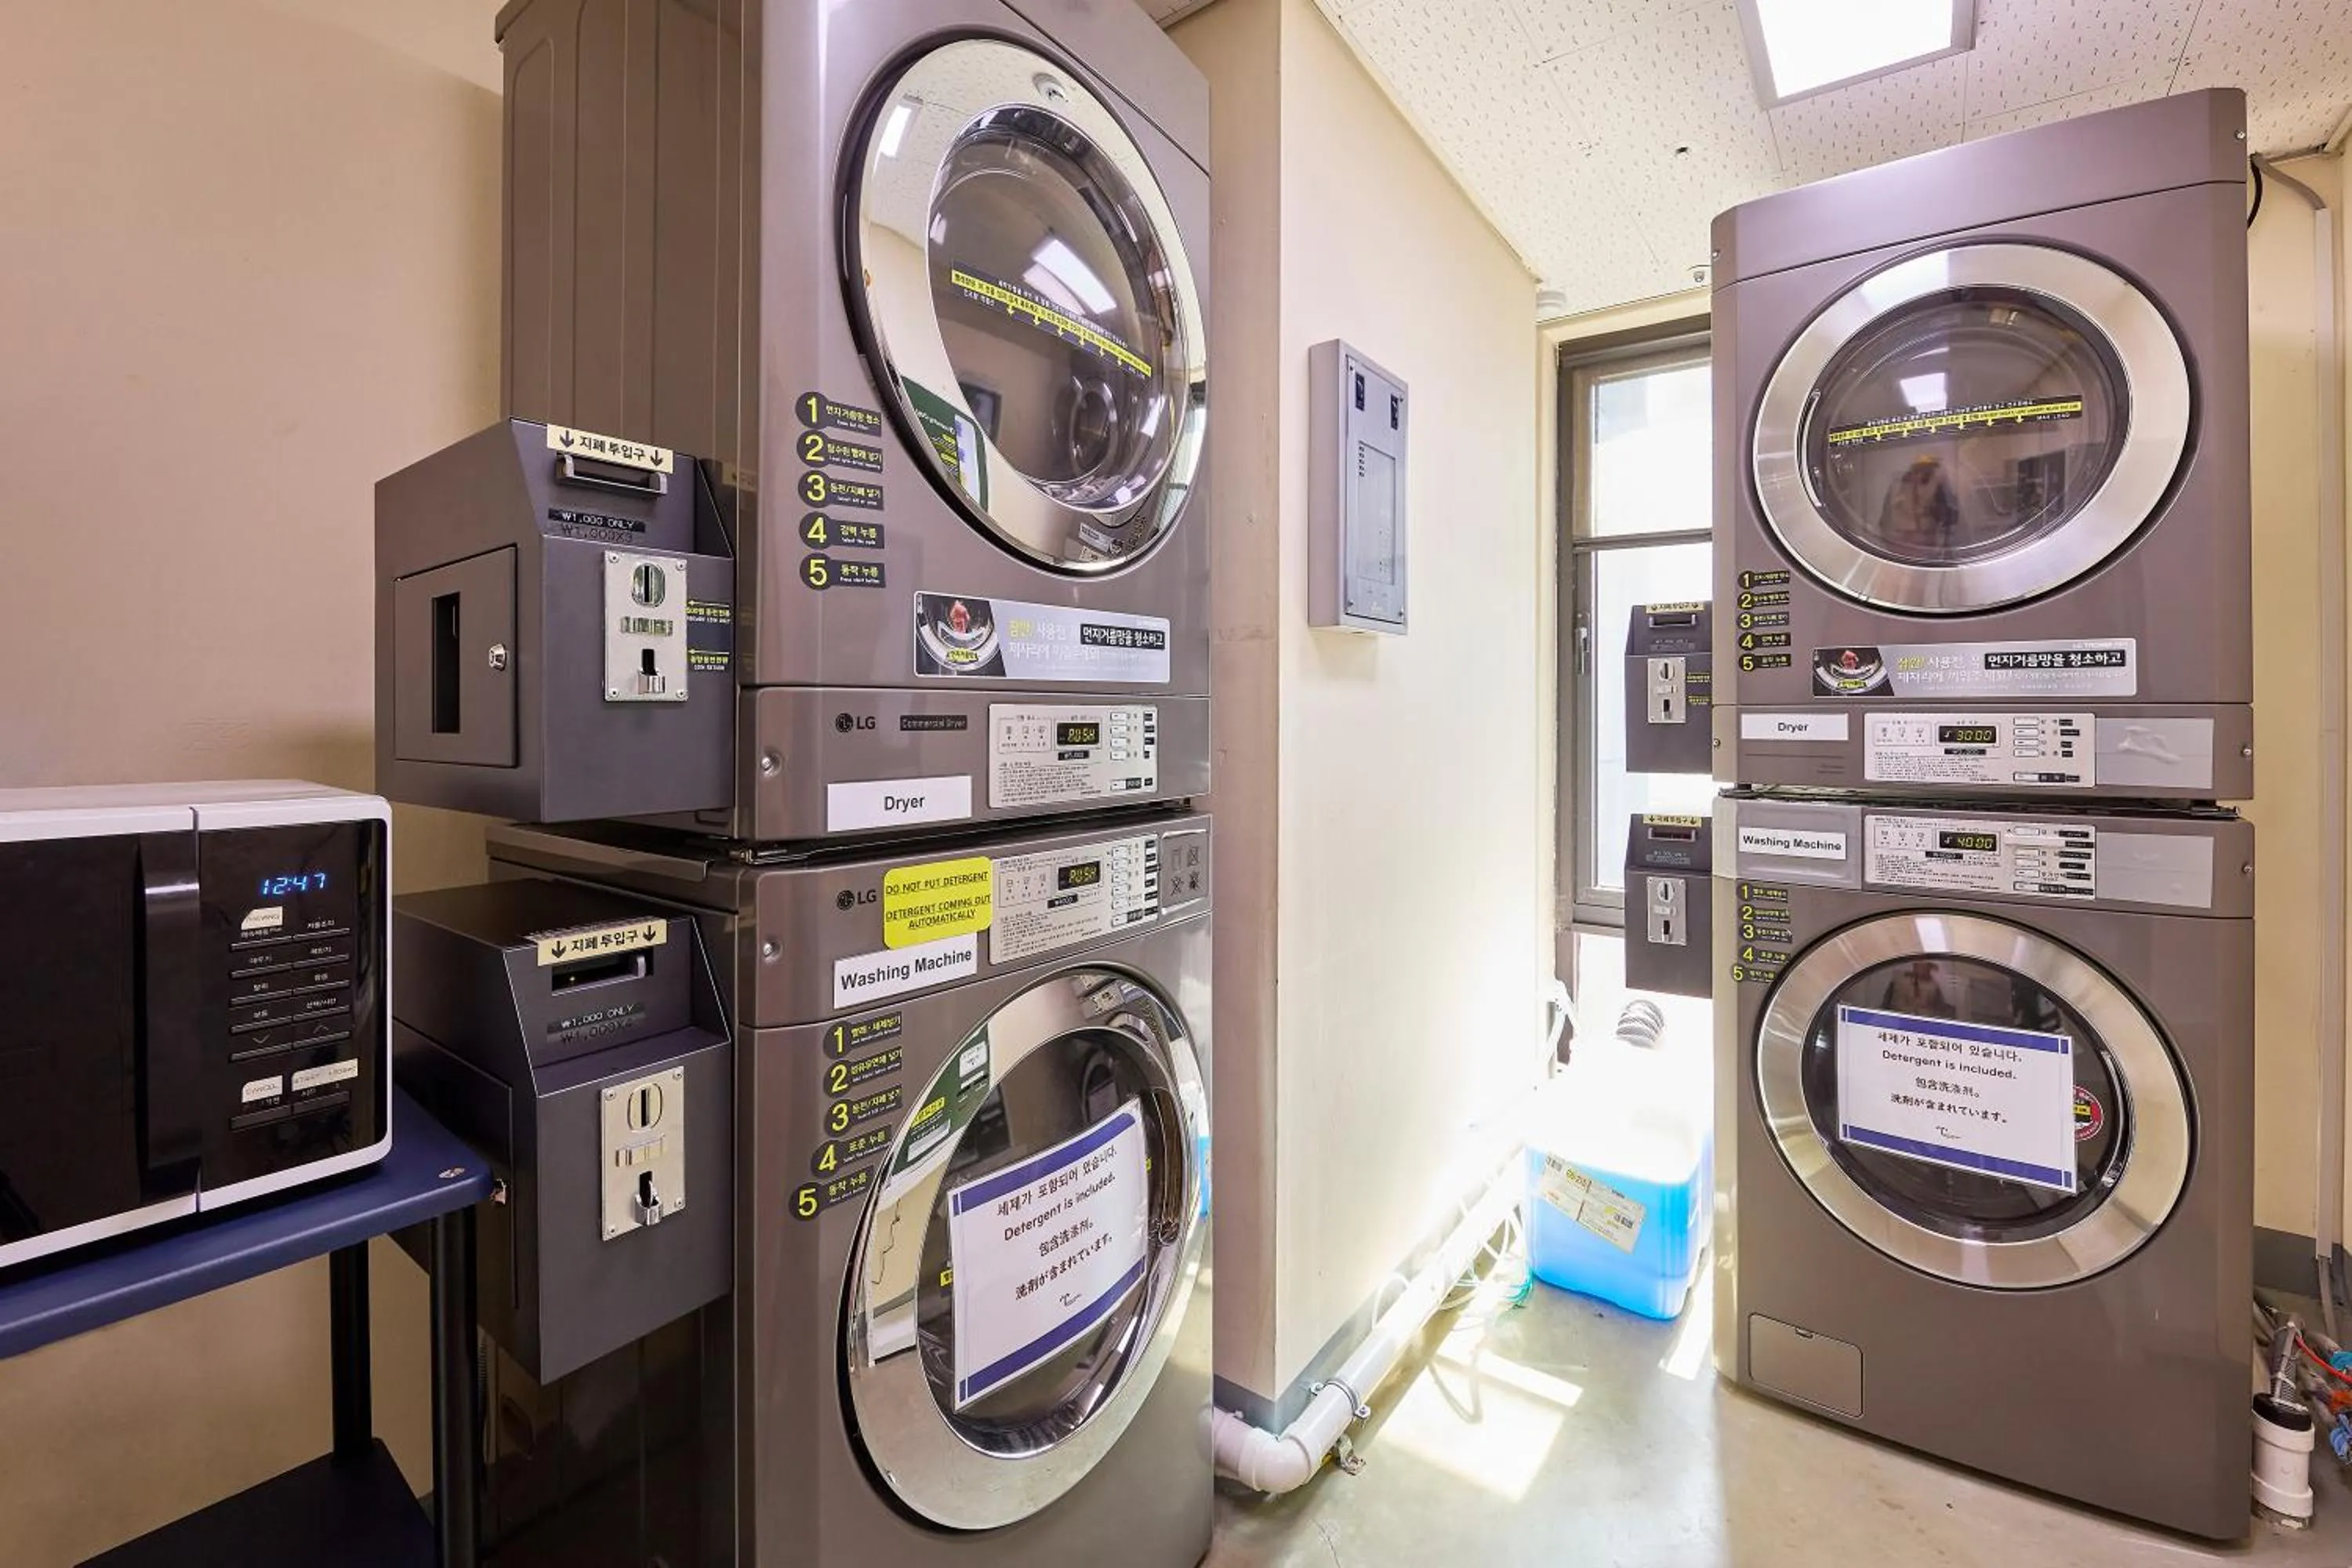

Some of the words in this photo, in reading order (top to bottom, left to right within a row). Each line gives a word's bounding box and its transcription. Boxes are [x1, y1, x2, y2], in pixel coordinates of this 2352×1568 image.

[806, 397, 818, 423] 1
[579, 435, 606, 452] 지폐
[608, 441, 645, 461] 투입구
[805, 434, 825, 461] 2
[807, 474, 826, 501] 3
[807, 517, 827, 543] 4
[809, 559, 828, 586] 5
[1743, 573, 1749, 587] 1
[1741, 593, 1752, 608] 2
[1740, 614, 1751, 627] 3
[1741, 634, 1754, 648] 4
[1743, 656, 1754, 670] 5
[1988, 652, 2066, 668] 먼지거름망을
[2068, 652, 2124, 667] 청소하고
[856, 716, 877, 730] LG
[1777, 720, 1809, 734] Dryer
[884, 796, 926, 813] Dryer
[1743, 835, 1791, 849] Washing
[1793, 837, 1842, 852] Machine
[261, 873, 327, 895] 12:47
[885, 884, 900, 895] DO
[902, 880, 921, 891] NOT
[924, 877, 941, 889] PUT
[943, 871, 989, 887] DETERGENT
[1742, 884, 1748, 899] 1
[857, 889, 877, 905] LG
[885, 903, 935, 922] DETERGENT
[938, 898, 973, 913] COMING
[975, 894, 992, 906] OUT
[907, 909, 976, 930] AUTOMATICALLY
[1742, 906, 1754, 920] 2
[571, 936, 598, 952] 지폐
[601, 930, 639, 947] 투입구
[1743, 924, 1754, 939] 3
[1743, 947, 1754, 964] 4
[840, 964, 910, 990] Washing
[914, 951, 972, 974] Machine
[1733, 966, 1744, 981] 5
[833, 1026, 844, 1052] 1
[1877, 1032, 1911, 1047] 세제가
[1916, 1036, 1963, 1054] 포함되어
[1969, 1044, 2023, 1062] 있습니다.
[1882, 1049, 1941, 1069] Detergent
[1945, 1058, 1955, 1071] is
[830, 1064, 849, 1093] 2
[832, 1103, 849, 1131] 3
[818, 1144, 837, 1171] 4
[1037, 1167, 1079, 1200] 포함되어
[1082, 1144, 1118, 1178] 있습니다.
[798, 1188, 818, 1216] 5
[1004, 1203, 1062, 1242] Detergent
[1063, 1198, 1073, 1211] is
[1075, 1174, 1116, 1204] included.
